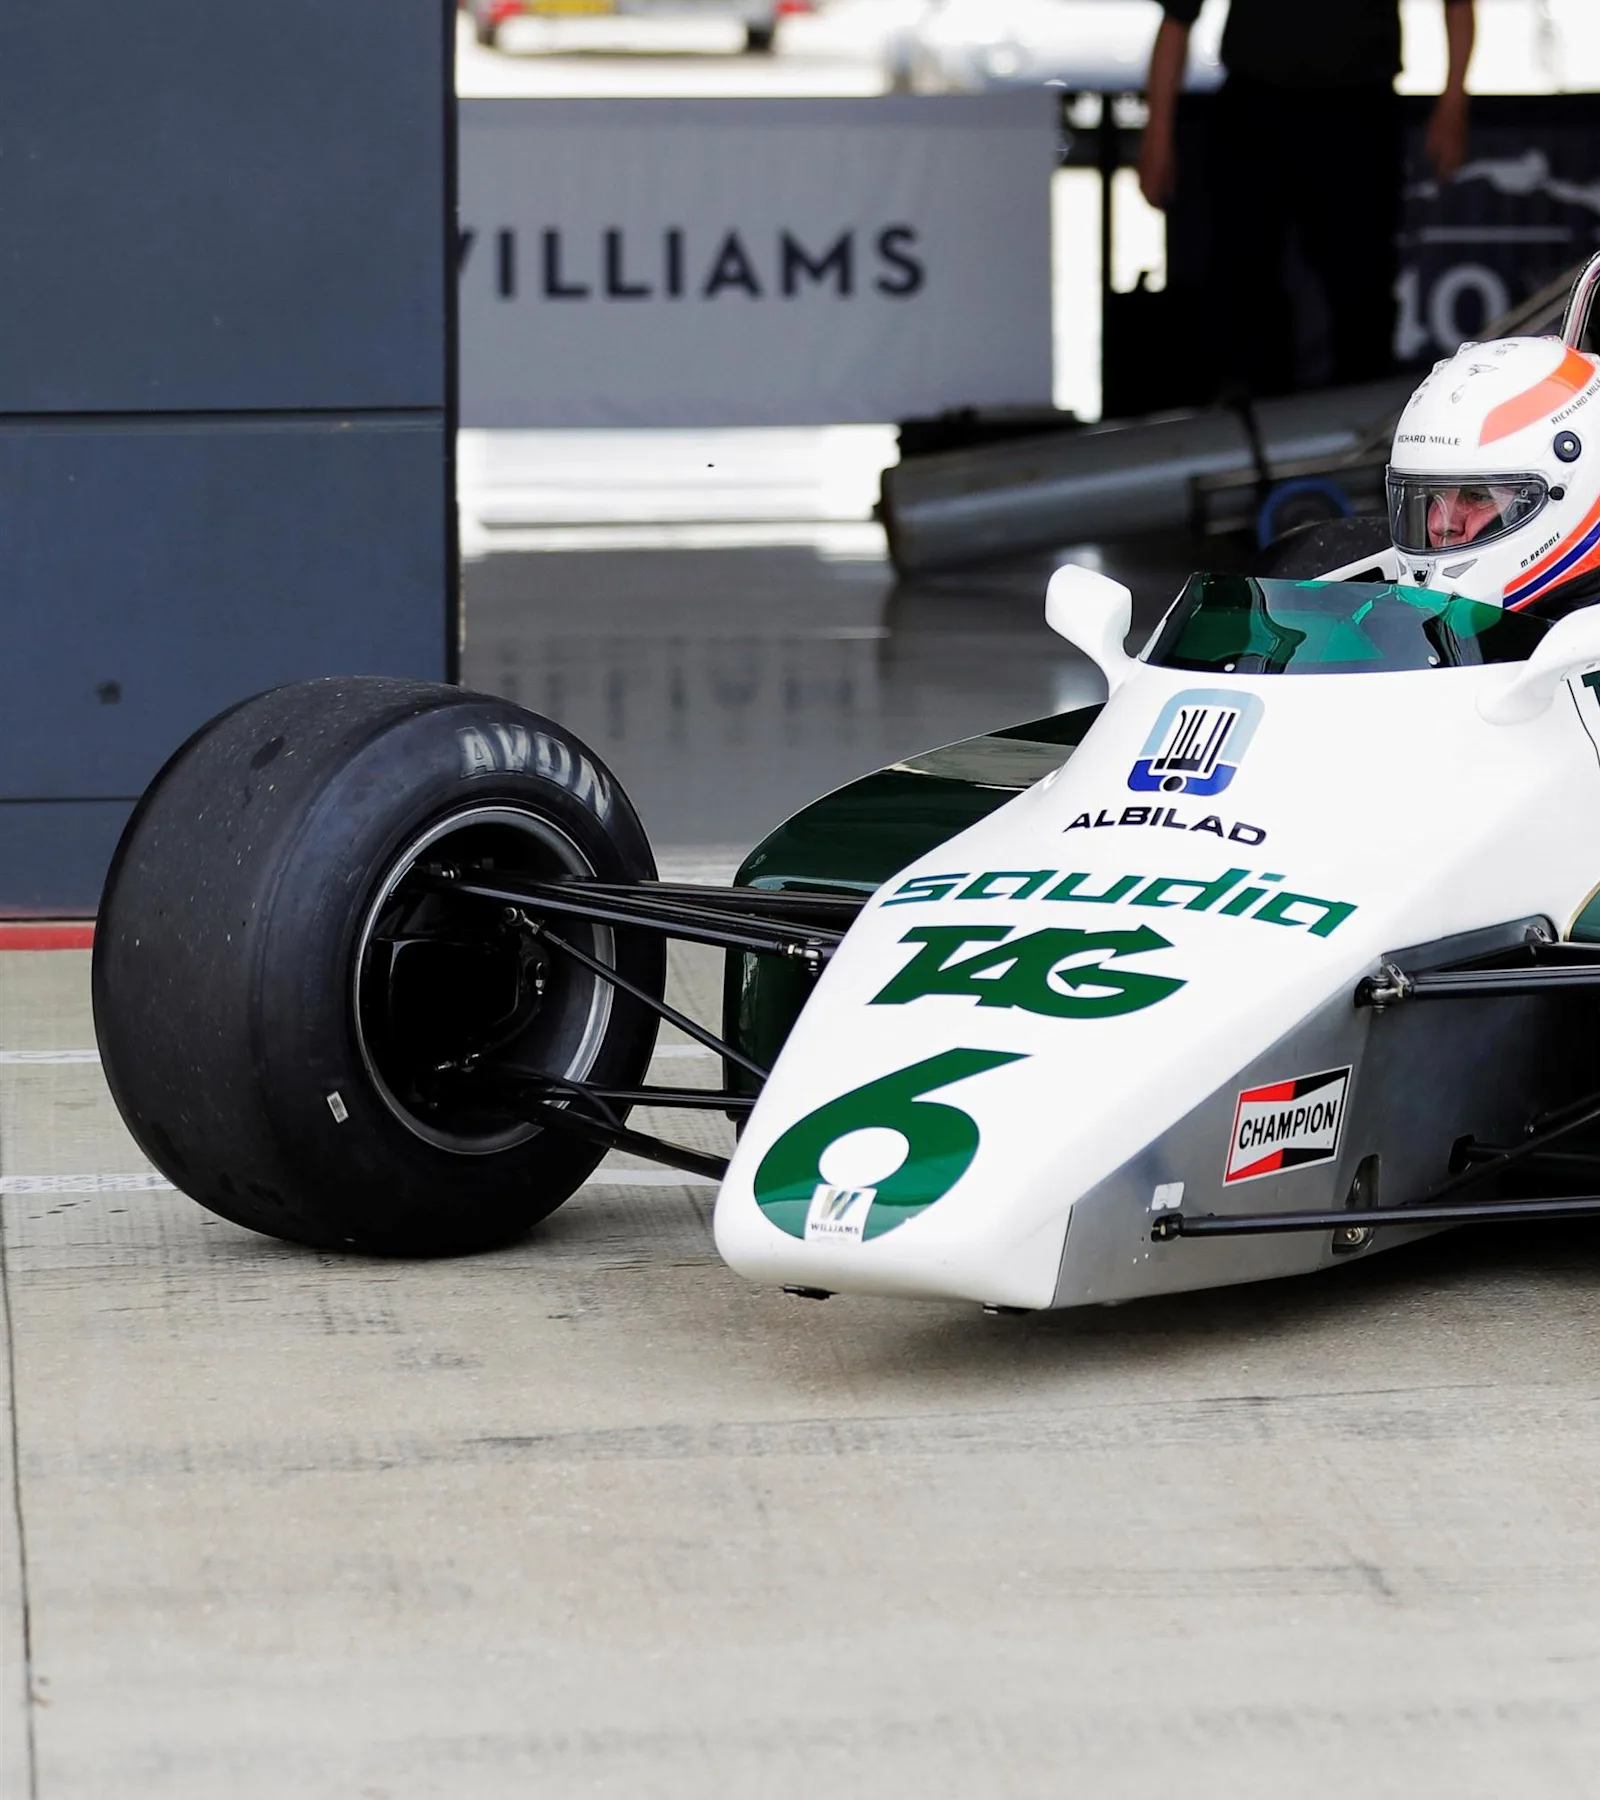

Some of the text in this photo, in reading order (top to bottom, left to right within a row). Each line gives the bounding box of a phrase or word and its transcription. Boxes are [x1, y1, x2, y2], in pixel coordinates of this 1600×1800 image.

[458, 223, 926, 298] ILLIAMS
[1550, 395, 1588, 426] RICHARD
[1429, 435, 1461, 446] MILLE
[456, 723, 613, 822] AVON
[1062, 806, 1267, 846] ALBILAD
[879, 868, 1359, 938] saudia
[865, 924, 1189, 1019] TAG
[754, 1047, 1035, 1242] 6
[1239, 1100, 1338, 1149] CHAMPION
[811, 1222, 860, 1235] WILLIAMS
